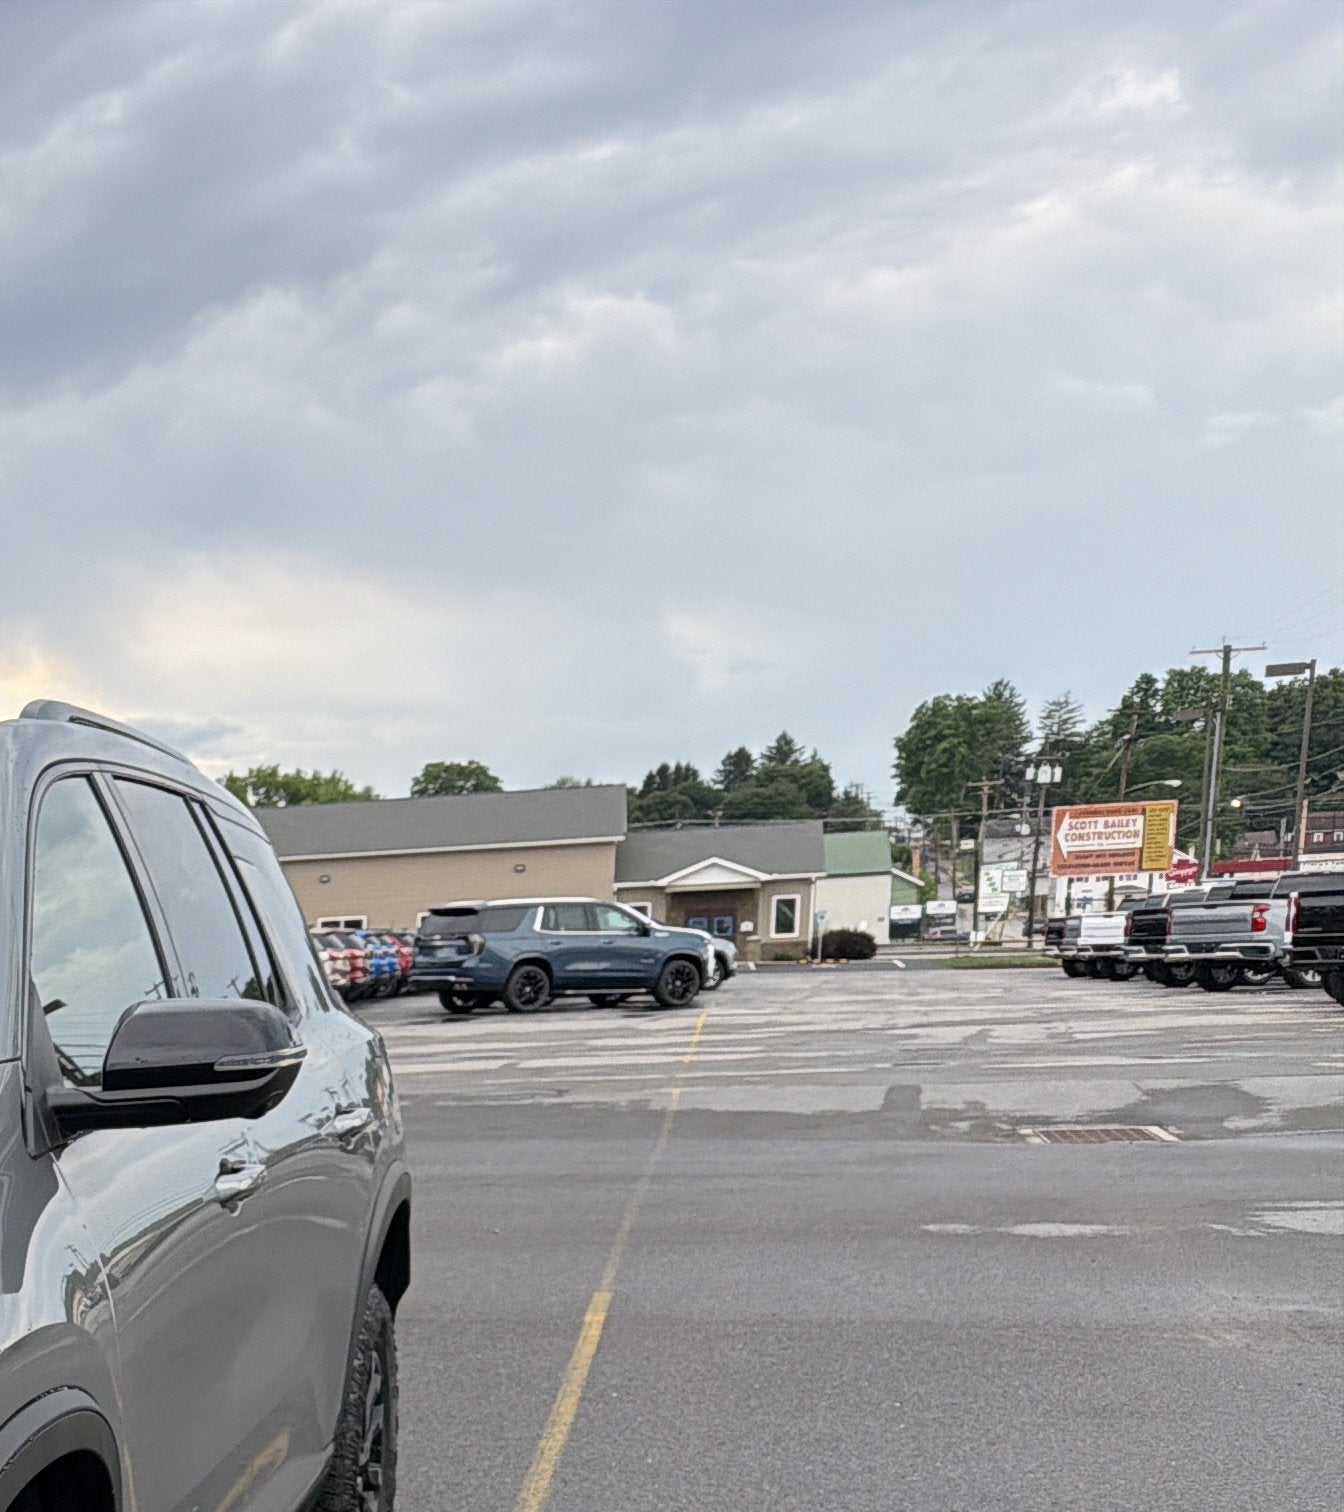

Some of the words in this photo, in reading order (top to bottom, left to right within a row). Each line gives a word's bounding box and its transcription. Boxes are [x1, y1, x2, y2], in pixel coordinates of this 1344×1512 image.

[1068, 820, 1099, 831] SCOTT
[1103, 818, 1138, 829] BAILEY
[1064, 829, 1141, 842] CONSTRUCTION
